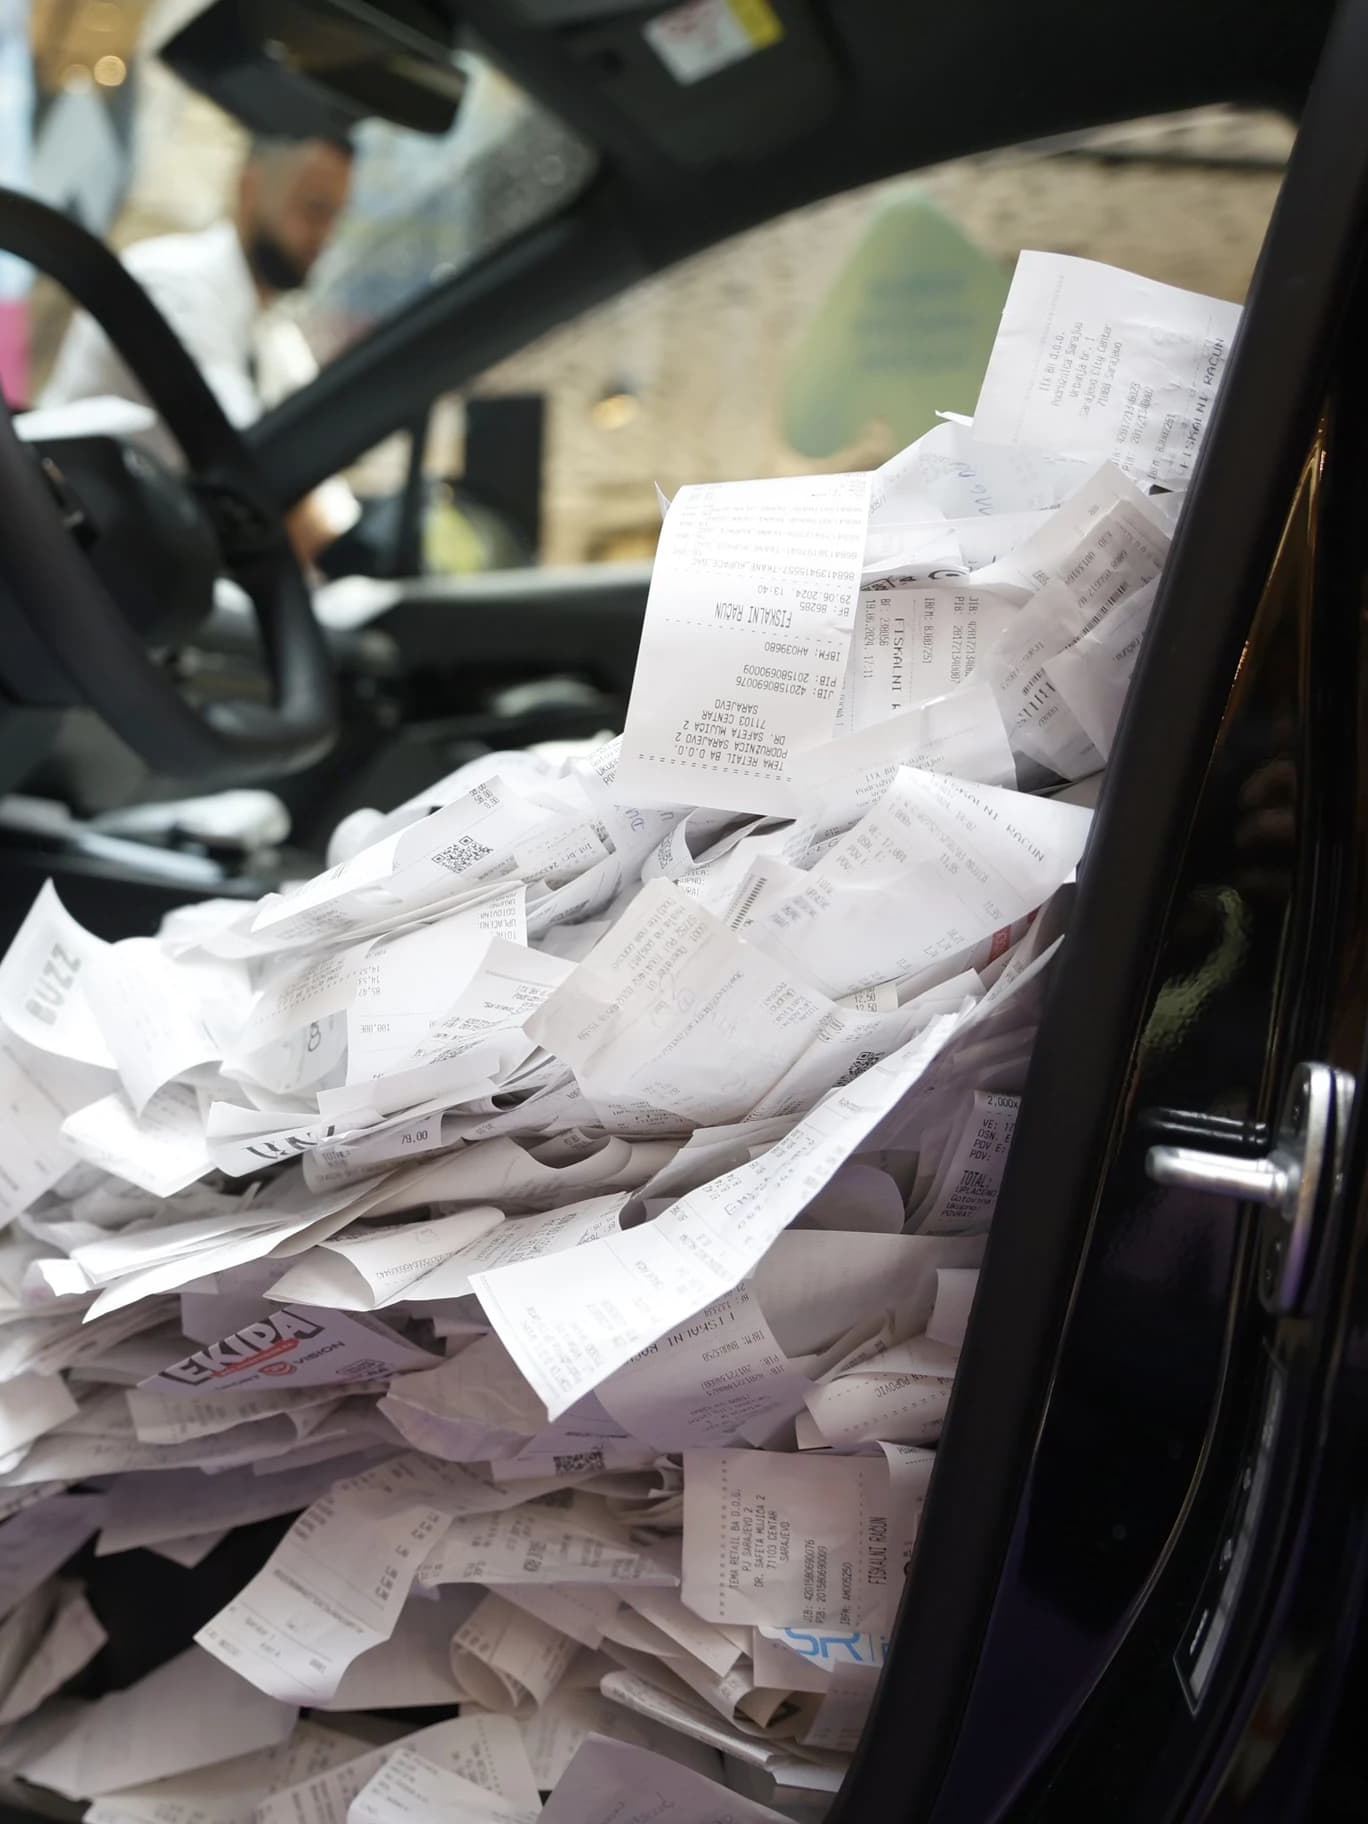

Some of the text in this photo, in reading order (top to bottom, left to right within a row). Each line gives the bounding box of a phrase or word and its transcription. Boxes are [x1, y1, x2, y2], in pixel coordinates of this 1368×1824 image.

[747, 605, 792, 628] FISKALNI
[812, 647, 841, 662] IBFM:
[742, 662, 837, 687] PIB: 201580690009
[734, 674, 834, 700] JIB: 4201580690076
[713, 698, 759, 715] SARAJEVO
[681, 719, 689, 730] 2
[700, 709, 766, 729] 71103 CENTAR
[673, 731, 681, 741] 2
[682, 732, 729, 749] SARAJEVO
[730, 727, 764, 742] SAFETA
[769, 733, 786, 745] DR.
[672, 743, 784, 771] TEMA RETAIL BA D.O.O.
[25, 943, 82, 1026] BUZZ
[982, 1118, 998, 1130] VE:
[972, 1139, 992, 1150] PDV
[968, 1148, 992, 1161] PDV:
[960, 1169, 993, 1188] TOTAL:
[158, 1309, 326, 1386] EKIPA
[292, 1341, 345, 1365] VISION
[731, 1519, 740, 1531] BA
[742, 1515, 752, 1556] SARAJEVO
[767, 1509, 777, 1569] 71103 CENTAR
[779, 1521, 789, 1561] SARAJEVO
[730, 1536, 739, 1565] RETAIL
[754, 1537, 764, 1568] SAFETA
[742, 1559, 751, 1572] PJ
[868, 1545, 886, 1584] FISKALNI
[754, 1572, 763, 1587] DR.
